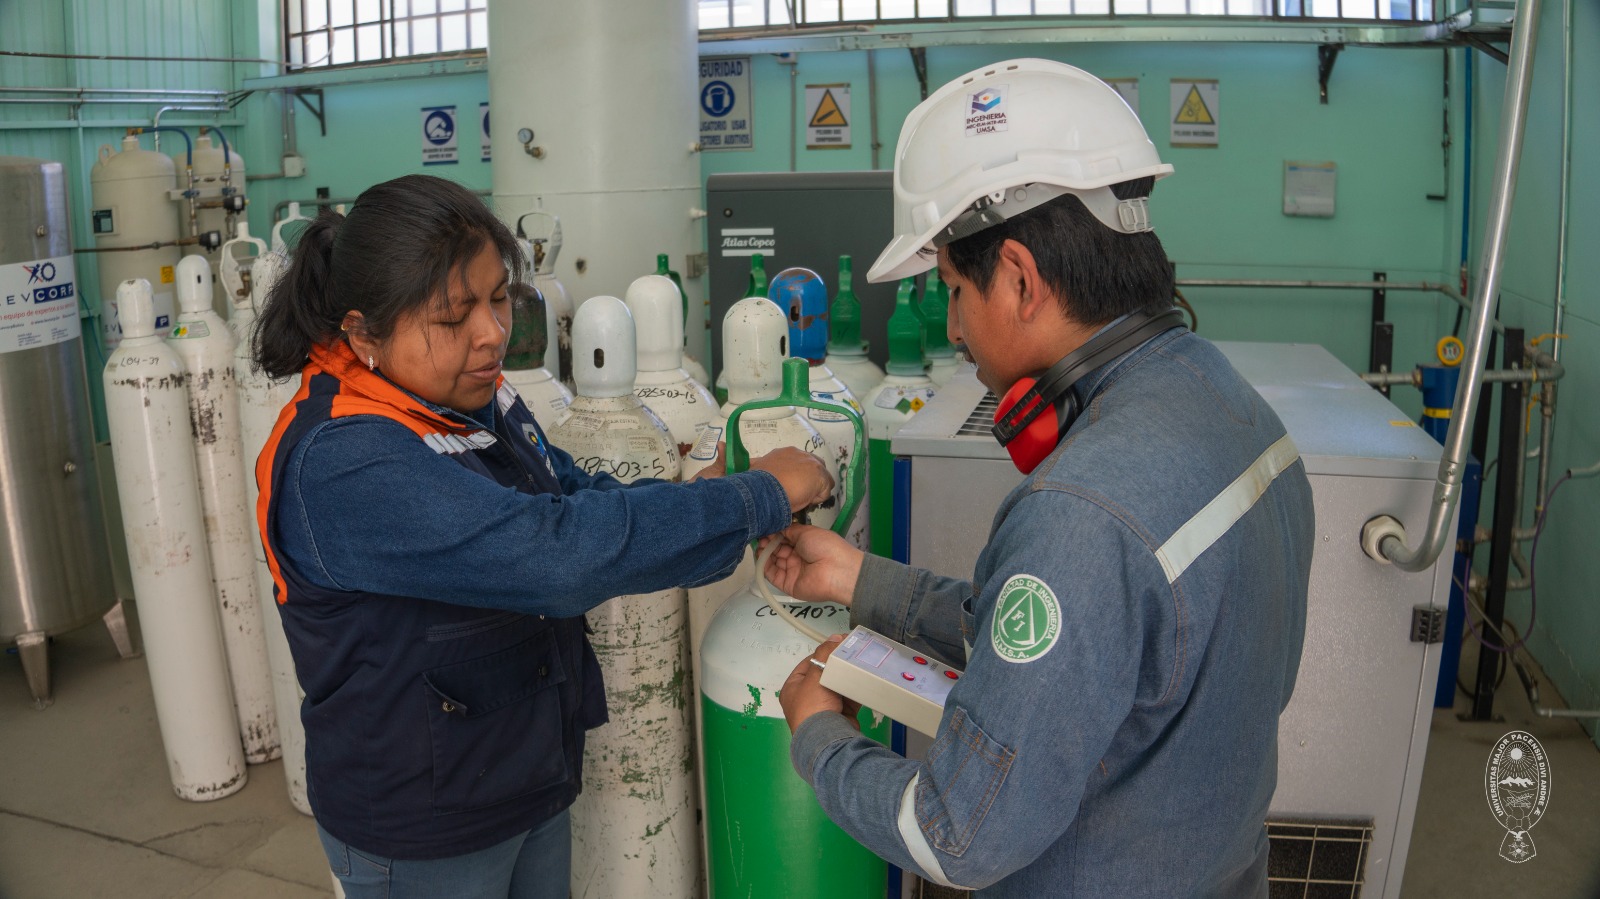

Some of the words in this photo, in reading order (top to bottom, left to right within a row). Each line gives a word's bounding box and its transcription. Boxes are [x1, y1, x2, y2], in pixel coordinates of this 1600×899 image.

[699, 61, 743, 78] GURIDAD
[966, 113, 1006, 124] INGENIERIA
[721, 237, 748, 247] Atlas
[748, 236, 775, 248] Copco
[0, 284, 74, 306] EVCORP
[634, 387, 697, 404] BES03-15
[1026, 580, 1039, 591] DE
